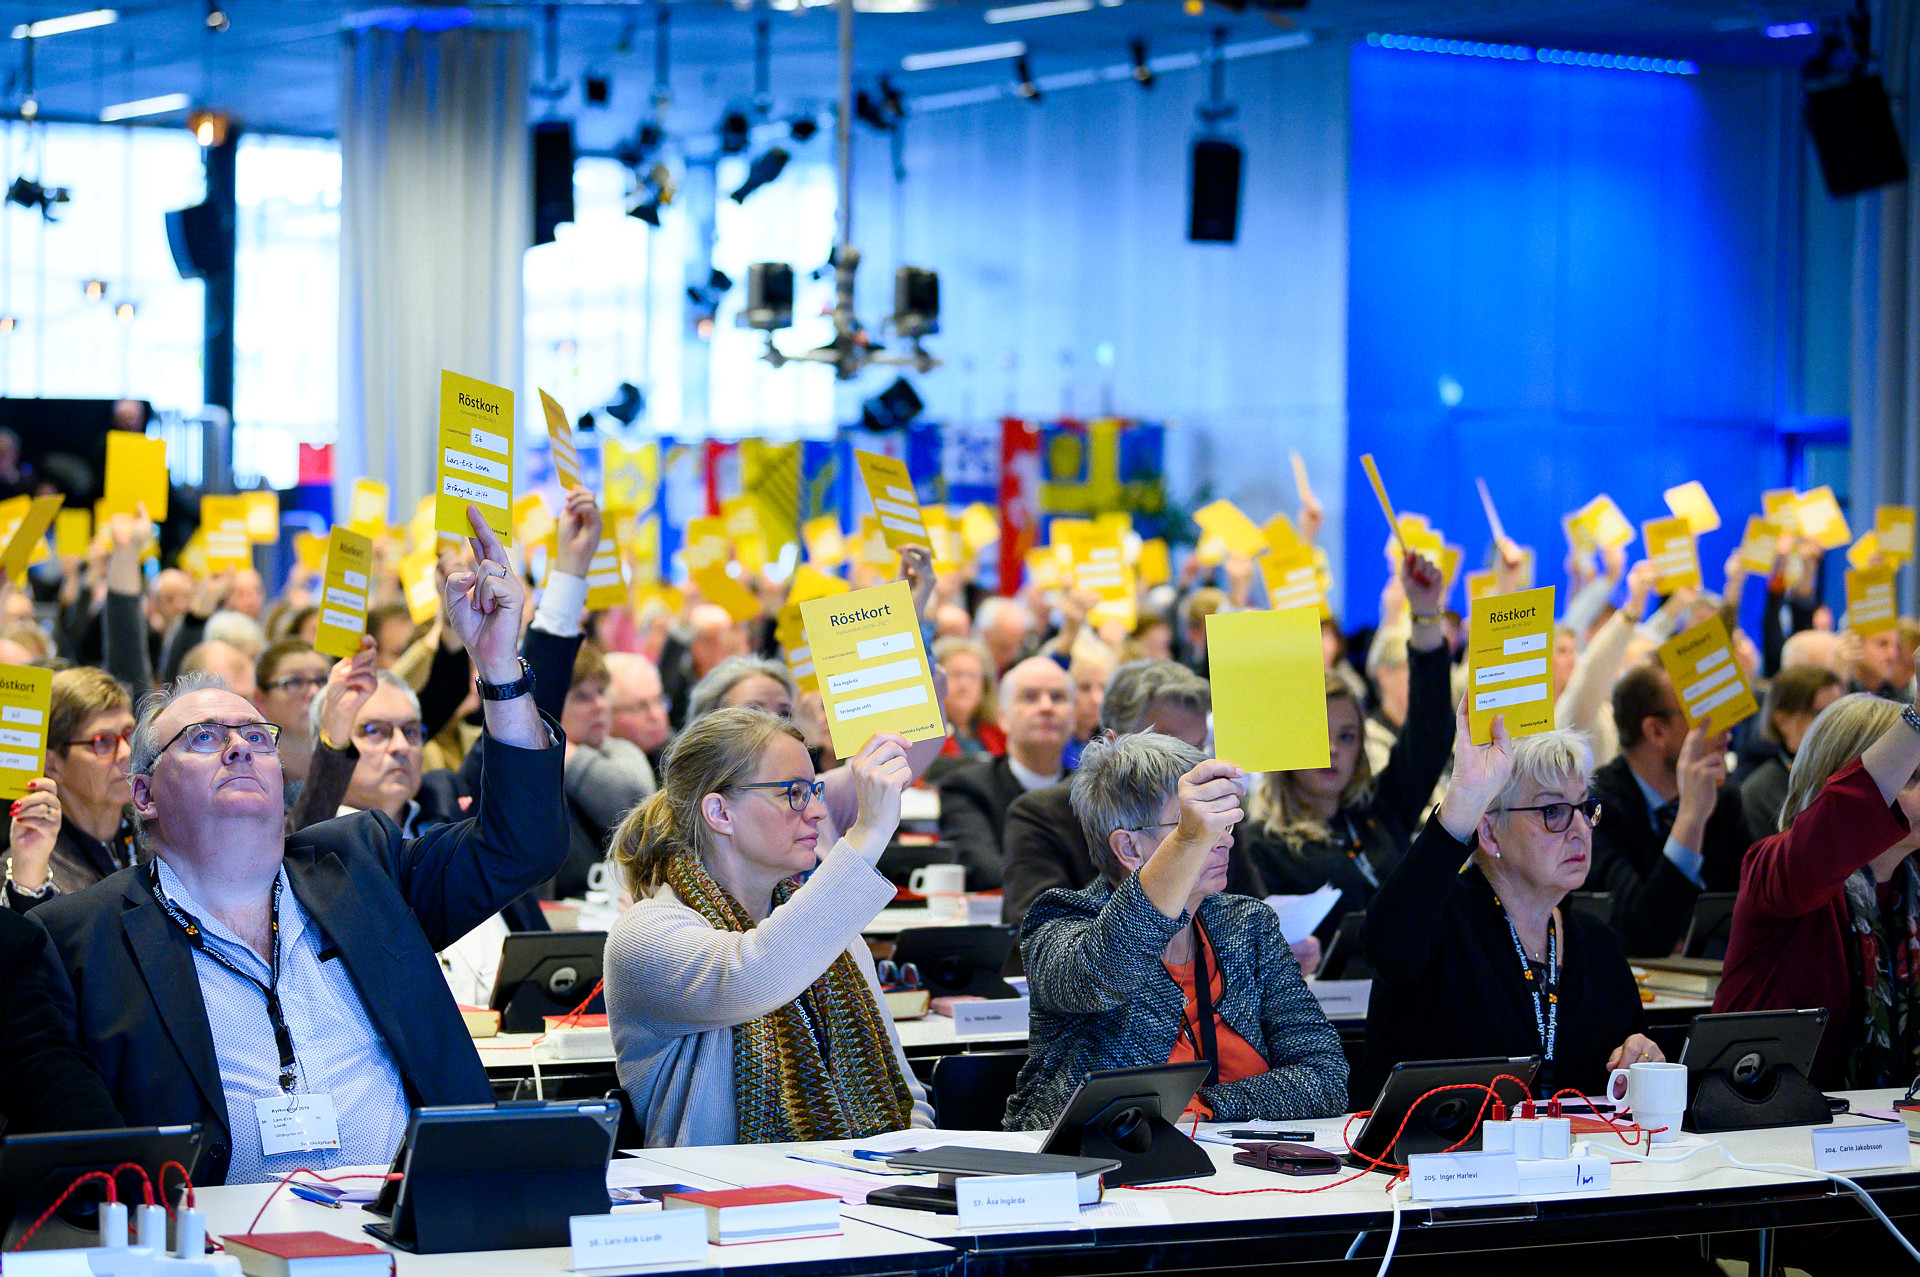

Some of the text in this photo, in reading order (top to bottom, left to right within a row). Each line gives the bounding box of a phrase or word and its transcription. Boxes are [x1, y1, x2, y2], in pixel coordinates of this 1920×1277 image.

[458, 392, 499, 415] Röstkort
[474, 434, 483, 442] 56
[830, 604, 892, 627] Röstkort
[1490, 606, 1536, 624] Röstkort
[0, 680, 35, 694] östkort
[167, 906, 190, 928] kyrkan
[1516, 944, 1528, 970] kyrkan
[794, 998, 811, 1029] Svenska
[1532, 992, 1544, 1024] Svenska
[1544, 1004, 1558, 1060] Svenska kyrkan
[986, 1196, 998, 1205] Åsa
[1000, 1196, 1026, 1206] Ingårda
[604, 1236, 638, 1245] Lars-Erik
